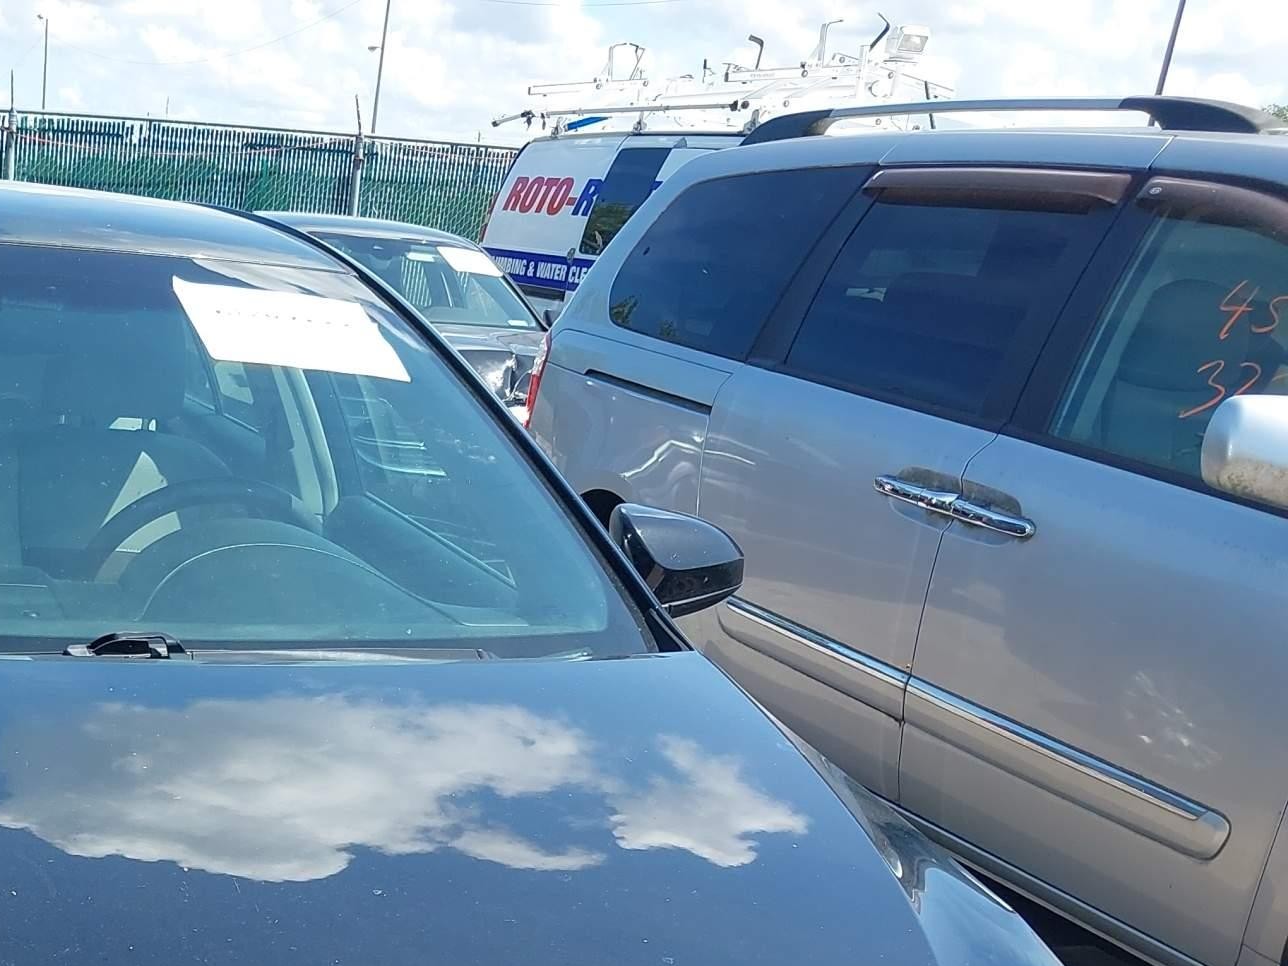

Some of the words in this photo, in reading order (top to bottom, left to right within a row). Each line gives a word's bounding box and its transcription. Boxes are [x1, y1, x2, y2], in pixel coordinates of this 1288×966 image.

[502, 176, 606, 217] ROTO-R
[527, 261, 535, 278] &
[536, 261, 568, 282] WATER
